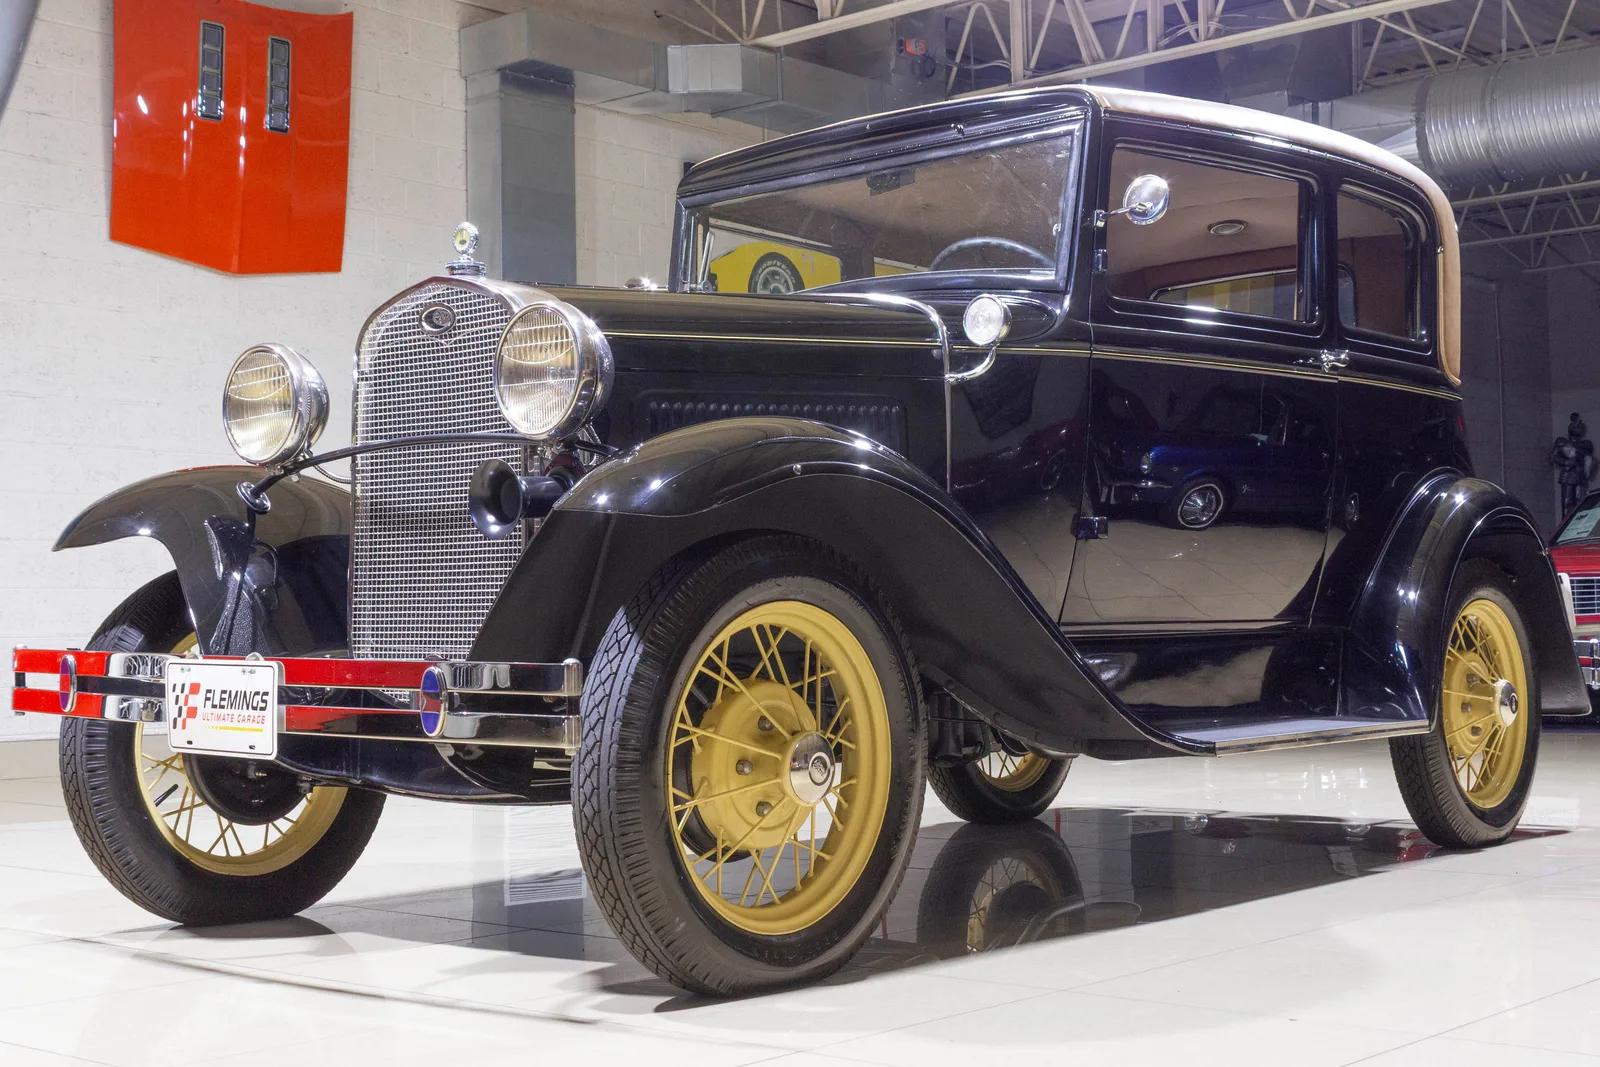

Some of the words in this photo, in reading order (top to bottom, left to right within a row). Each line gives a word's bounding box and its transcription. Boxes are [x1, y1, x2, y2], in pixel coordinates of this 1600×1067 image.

[203, 689, 269, 711] FLEMINGS
[202, 712, 235, 723] ULTIMATE
[237, 714, 266, 725] GARAGE
